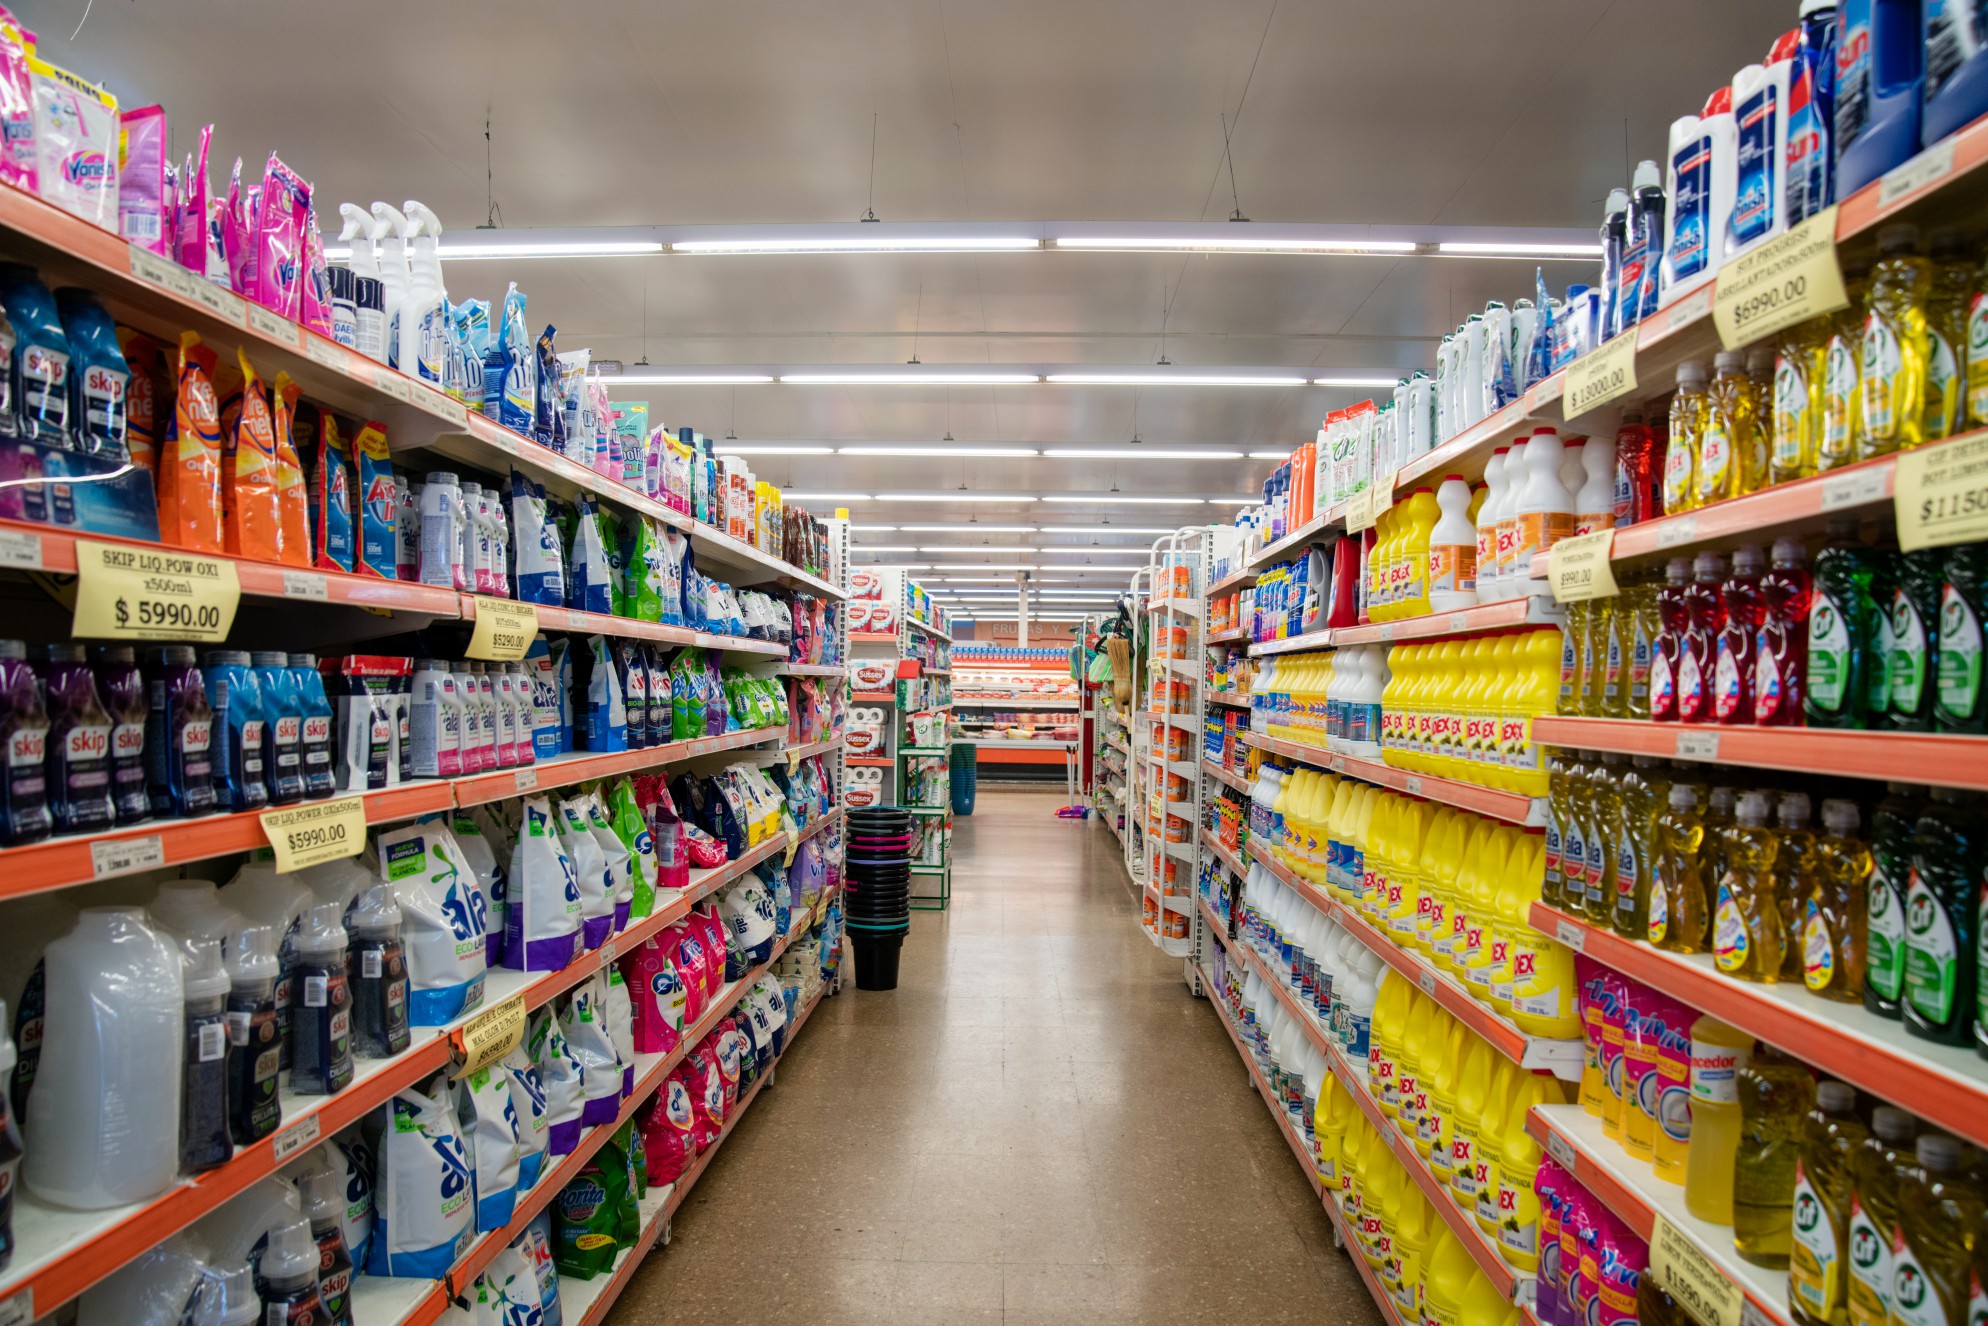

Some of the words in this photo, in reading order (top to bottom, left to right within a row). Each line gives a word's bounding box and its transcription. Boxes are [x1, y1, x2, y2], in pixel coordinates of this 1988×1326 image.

[1734, 275, 1807, 324] $6990.00
[28, 351, 63, 385] skip
[90, 370, 122, 397] skip
[1571, 392, 1576, 407] $
[1581, 367, 1624, 403] 13000.00
[103, 550, 135, 566] SKIP
[140, 555, 193, 572] LIQ.POW
[1430, 555, 1440, 571] EX
[144, 579, 192, 594] x500ml
[1561, 569, 1591, 586] $990.00
[115, 598, 129, 627] $
[139, 601, 219, 627] 5990.00
[849, 609, 865, 617] ussex
[993, 624, 1043, 634] FRUAS
[1053, 625, 1059, 634] Y
[493, 634, 524, 647] $5290.00
[858, 670, 884, 679] Sussex
[278, 721, 298, 742] skip
[306, 720, 327, 741] skip
[1432, 717, 1450, 735] DEX
[71, 731, 105, 755] skip
[118, 729, 141, 752] skip
[186, 726, 209, 747] skip
[846, 735, 871, 743] Sussex
[14, 735, 44, 760] skip
[288, 823, 346, 849] $5990.00
[456, 941, 472, 955] ECO
[1514, 953, 1535, 976] DEX
[497, 996, 522, 1016] COMBATE
[24, 1027, 42, 1043] sk
[1379, 1063, 1393, 1077] DEX
[1400, 1079, 1415, 1094] DEX
[1452, 1141, 1470, 1159] DEX
[441, 1196, 462, 1214] ECO
[1363, 1219, 1382, 1233] DEX
[1855, 1232, 1879, 1261] Cif
[322, 1275, 347, 1296] skip
[1665, 1263, 1720, 1326] $1590.00
[1896, 1271, 1922, 1300] Cif
[1436, 1310, 1455, 1325] COMÚN
